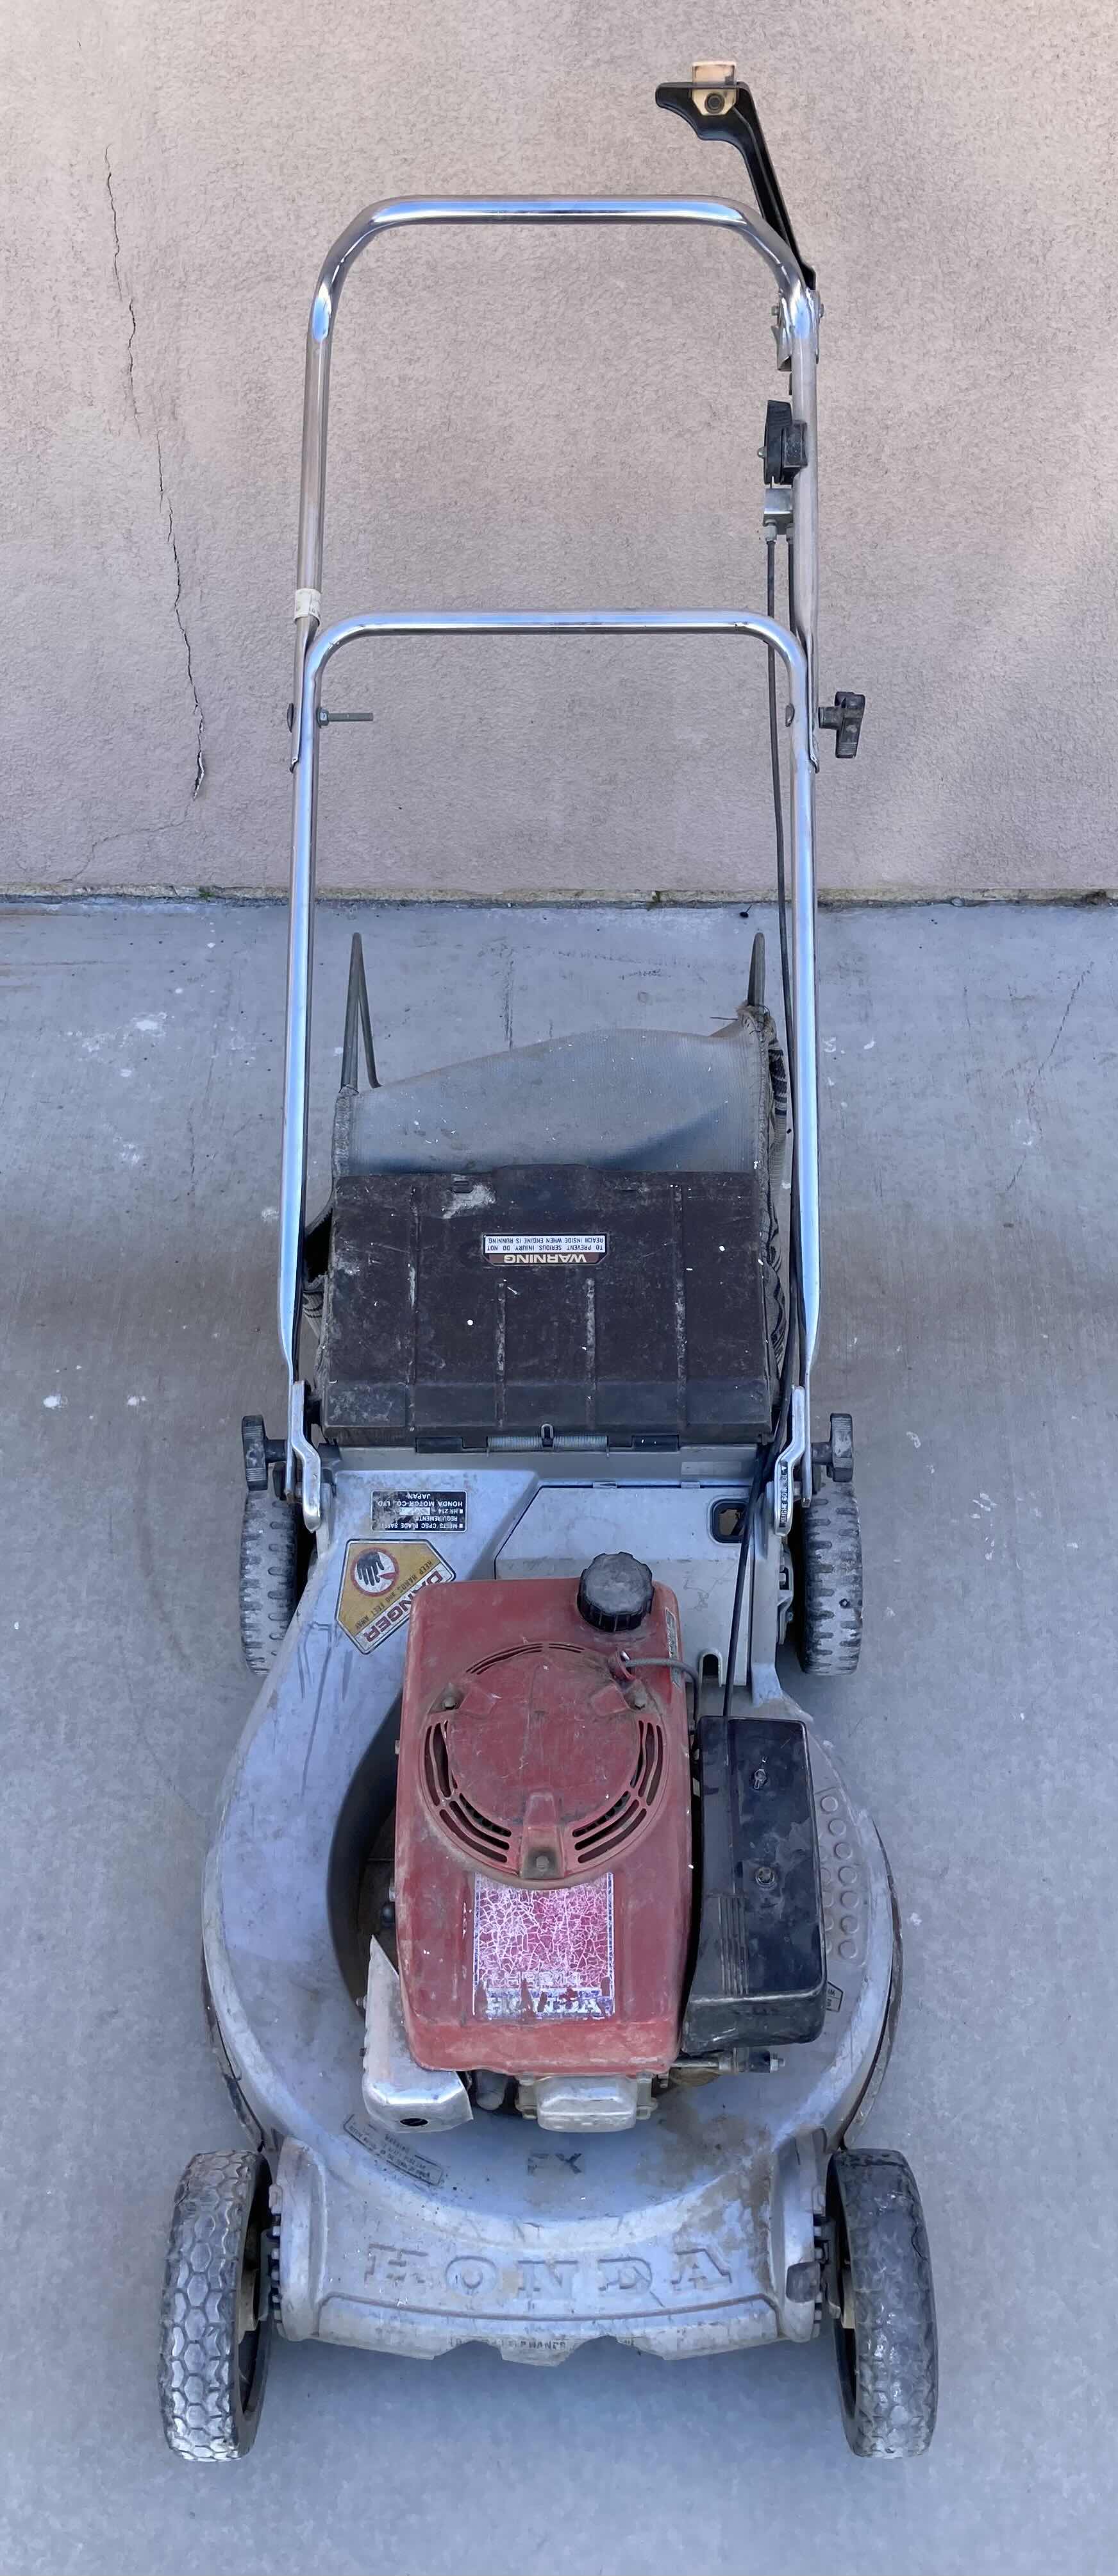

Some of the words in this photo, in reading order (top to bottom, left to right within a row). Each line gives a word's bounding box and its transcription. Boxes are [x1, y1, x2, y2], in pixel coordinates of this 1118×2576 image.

[505, 1254, 587, 1263] WARNING
[419, 1560, 433, 1576] KEEP
[397, 1574, 416, 1594] HANDS
[371, 1602, 385, 1615] FEET
[355, 1615, 370, 1630] AWAY
[363, 2243, 732, 2298] HONDA
